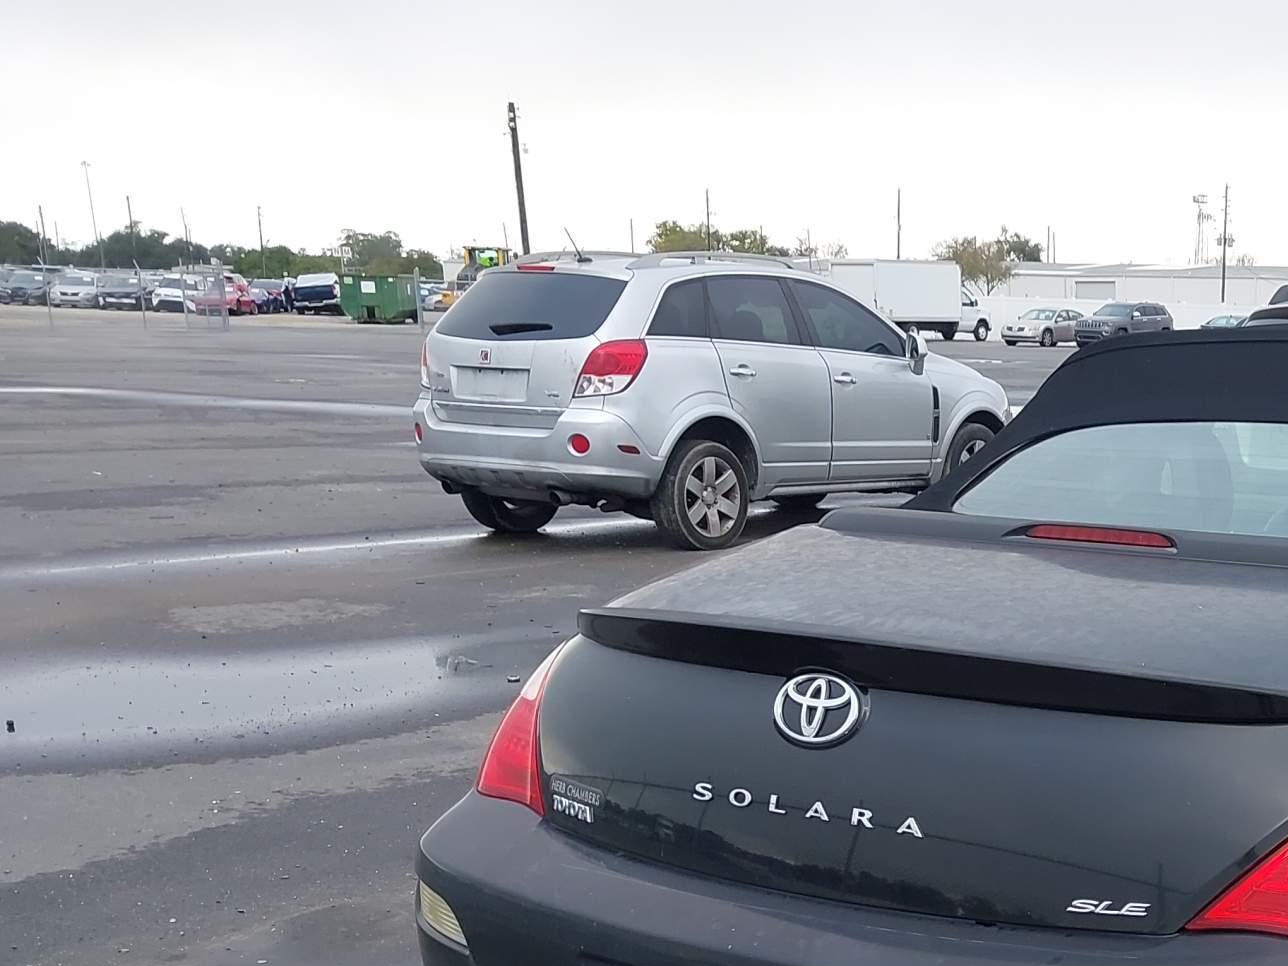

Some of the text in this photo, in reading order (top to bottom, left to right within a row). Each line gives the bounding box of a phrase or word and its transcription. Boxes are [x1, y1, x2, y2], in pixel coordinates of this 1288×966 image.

[551, 779, 601, 806] HERB CHAMBERS
[552, 794, 595, 824] TOYOTA
[692, 782, 924, 838] SOLARA
[1065, 898, 1152, 917] SLE
